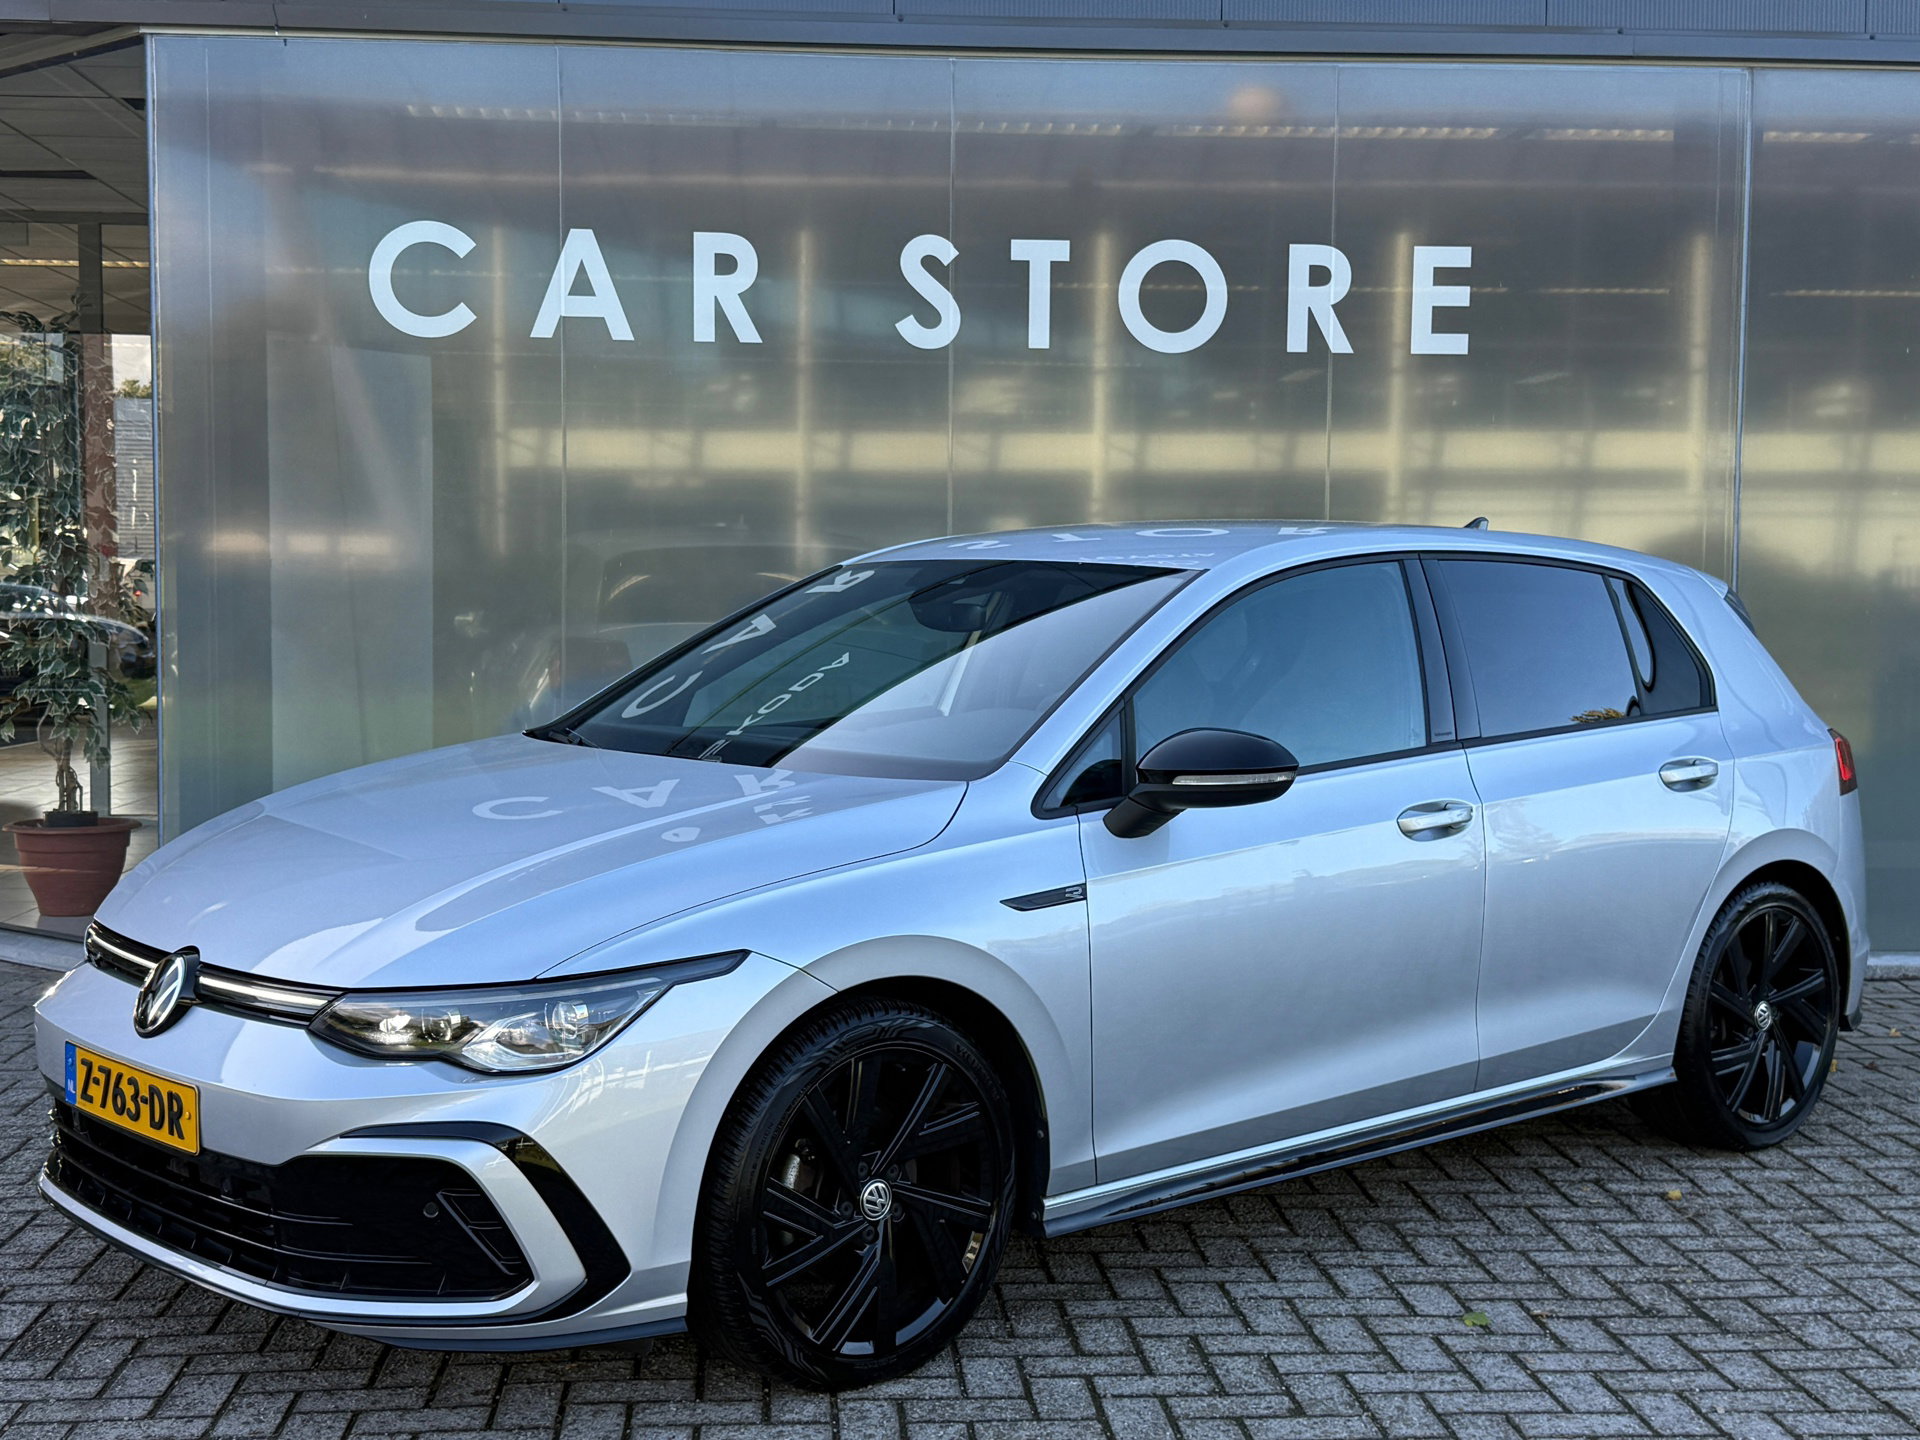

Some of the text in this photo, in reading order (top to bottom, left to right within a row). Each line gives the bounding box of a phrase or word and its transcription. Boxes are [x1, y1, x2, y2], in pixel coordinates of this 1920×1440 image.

[368, 220, 1472, 355] CAR STORE
[80, 1057, 185, 1140] Z-763-DR
